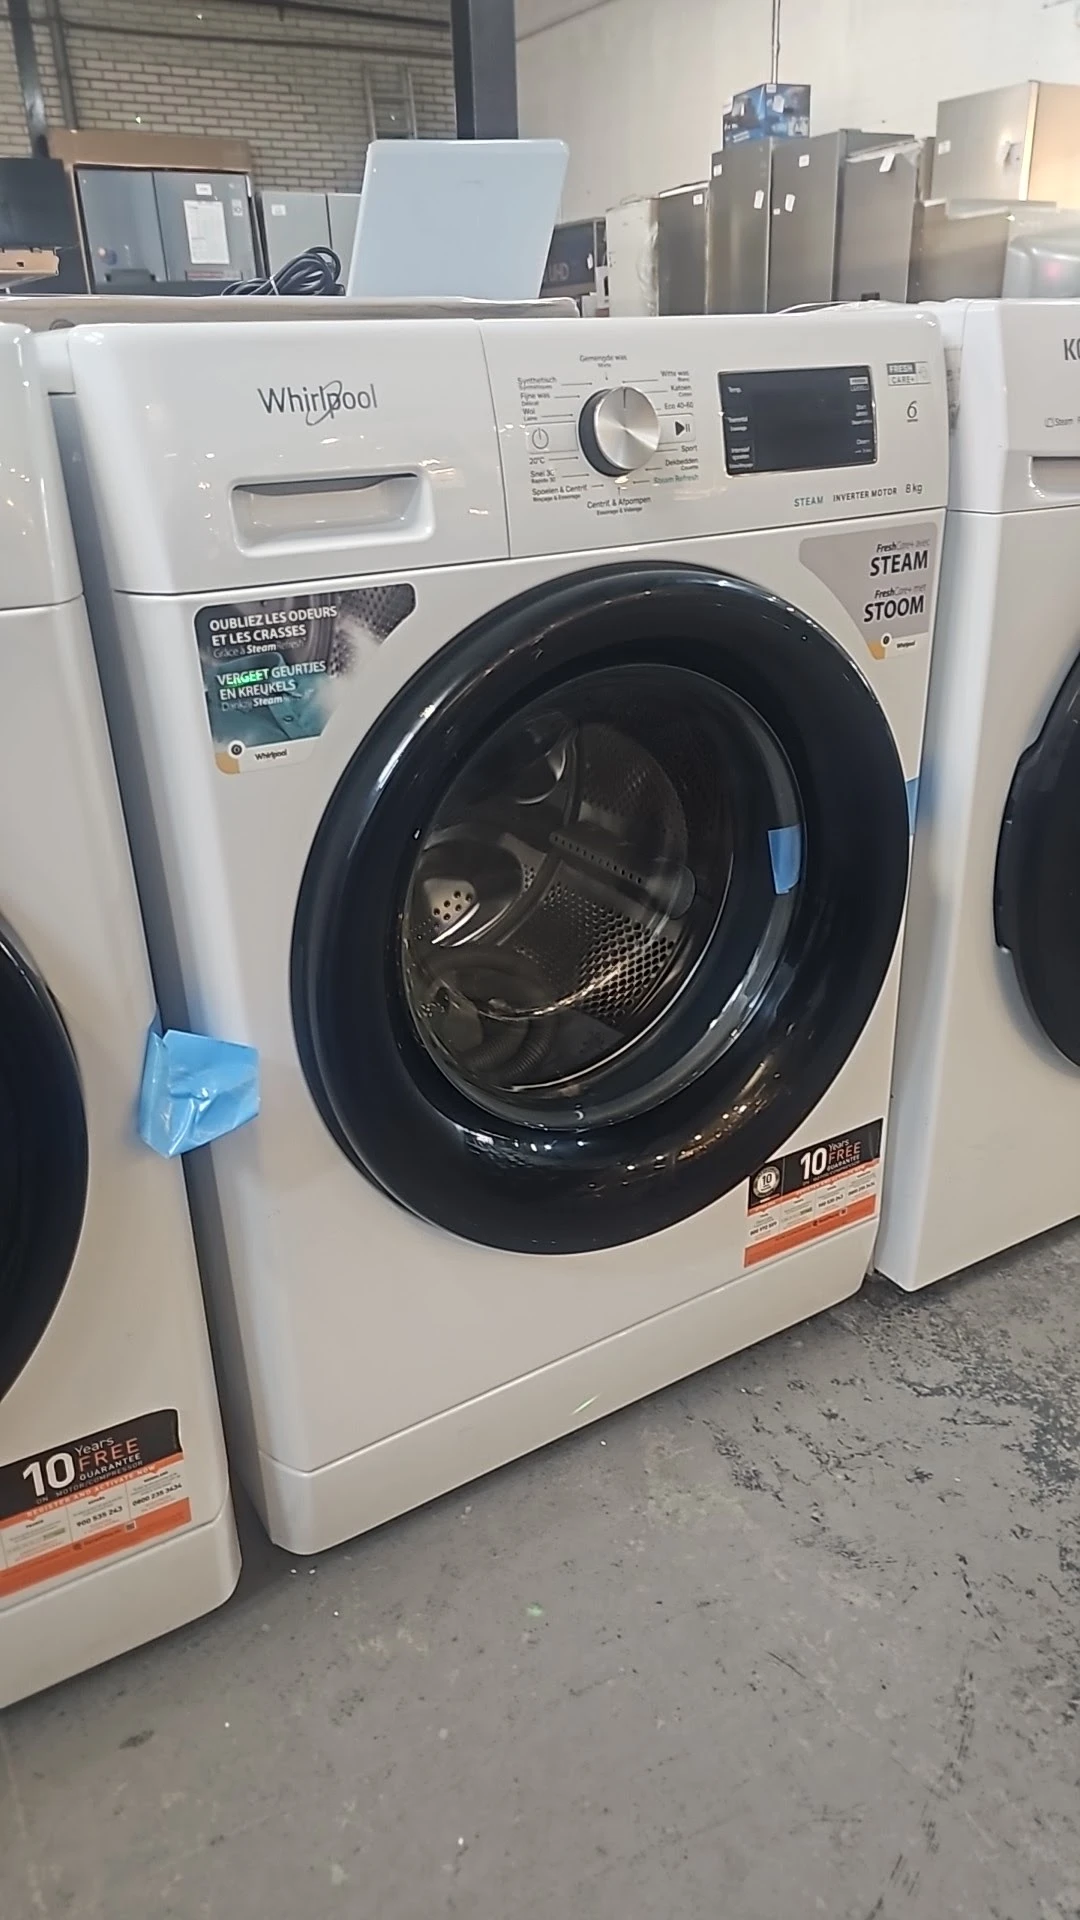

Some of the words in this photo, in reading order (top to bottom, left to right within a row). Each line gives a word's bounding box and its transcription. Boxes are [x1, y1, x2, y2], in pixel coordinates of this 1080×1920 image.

[1064, 339, 1080, 360] K
[891, 374, 915, 385] CARE+
[257, 380, 378, 426] Whirlpool
[664, 402, 677, 410] Eco
[906, 400, 918, 420] 6
[681, 445, 698, 453] Sport
[665, 457, 698, 467] Dekbedden
[618, 496, 651, 505] Afpompen
[794, 495, 824, 507] STEAM
[832, 490, 869, 502] INVERTER
[871, 487, 897, 497] MOTOR
[869, 549, 929, 577] STEAM
[209, 614, 264, 632] OUBLIEZ
[265, 611, 287, 625] LES
[288, 605, 338, 622] ODEURS
[863, 594, 925, 623] STOOM
[211, 634, 227, 647] ET
[229, 631, 252, 644] LES
[253, 624, 307, 641] CRASSES
[216, 667, 270, 687] VERGEET
[271, 660, 326, 679] GEURTJES
[220, 688, 237, 701] EN
[238, 679, 297, 698] KREUKELS
[254, 748, 288, 761] Whirlpool
[828, 1139, 849, 1152] Years
[800, 1146, 828, 1181] 10
[829, 1141, 861, 1165] FREE
[827, 1154, 860, 1171] GUARANTEE
[761, 1173, 773, 1186] 10
[74, 1436, 115, 1457] Years
[22, 1452, 76, 1498] 10
[78, 1437, 140, 1473] FREE
[78, 1452, 142, 1482] GUARANTEE
[36, 1496, 49, 1505] ON
[55, 1460, 144, 1498] MOTOR/COMPRESSOR
[74, 1489, 92, 1502] AND
[94, 1473, 134, 1492] ACTIVATE
[135, 1464, 156, 1477] NOW
[76, 1518, 92, 1528] 900
